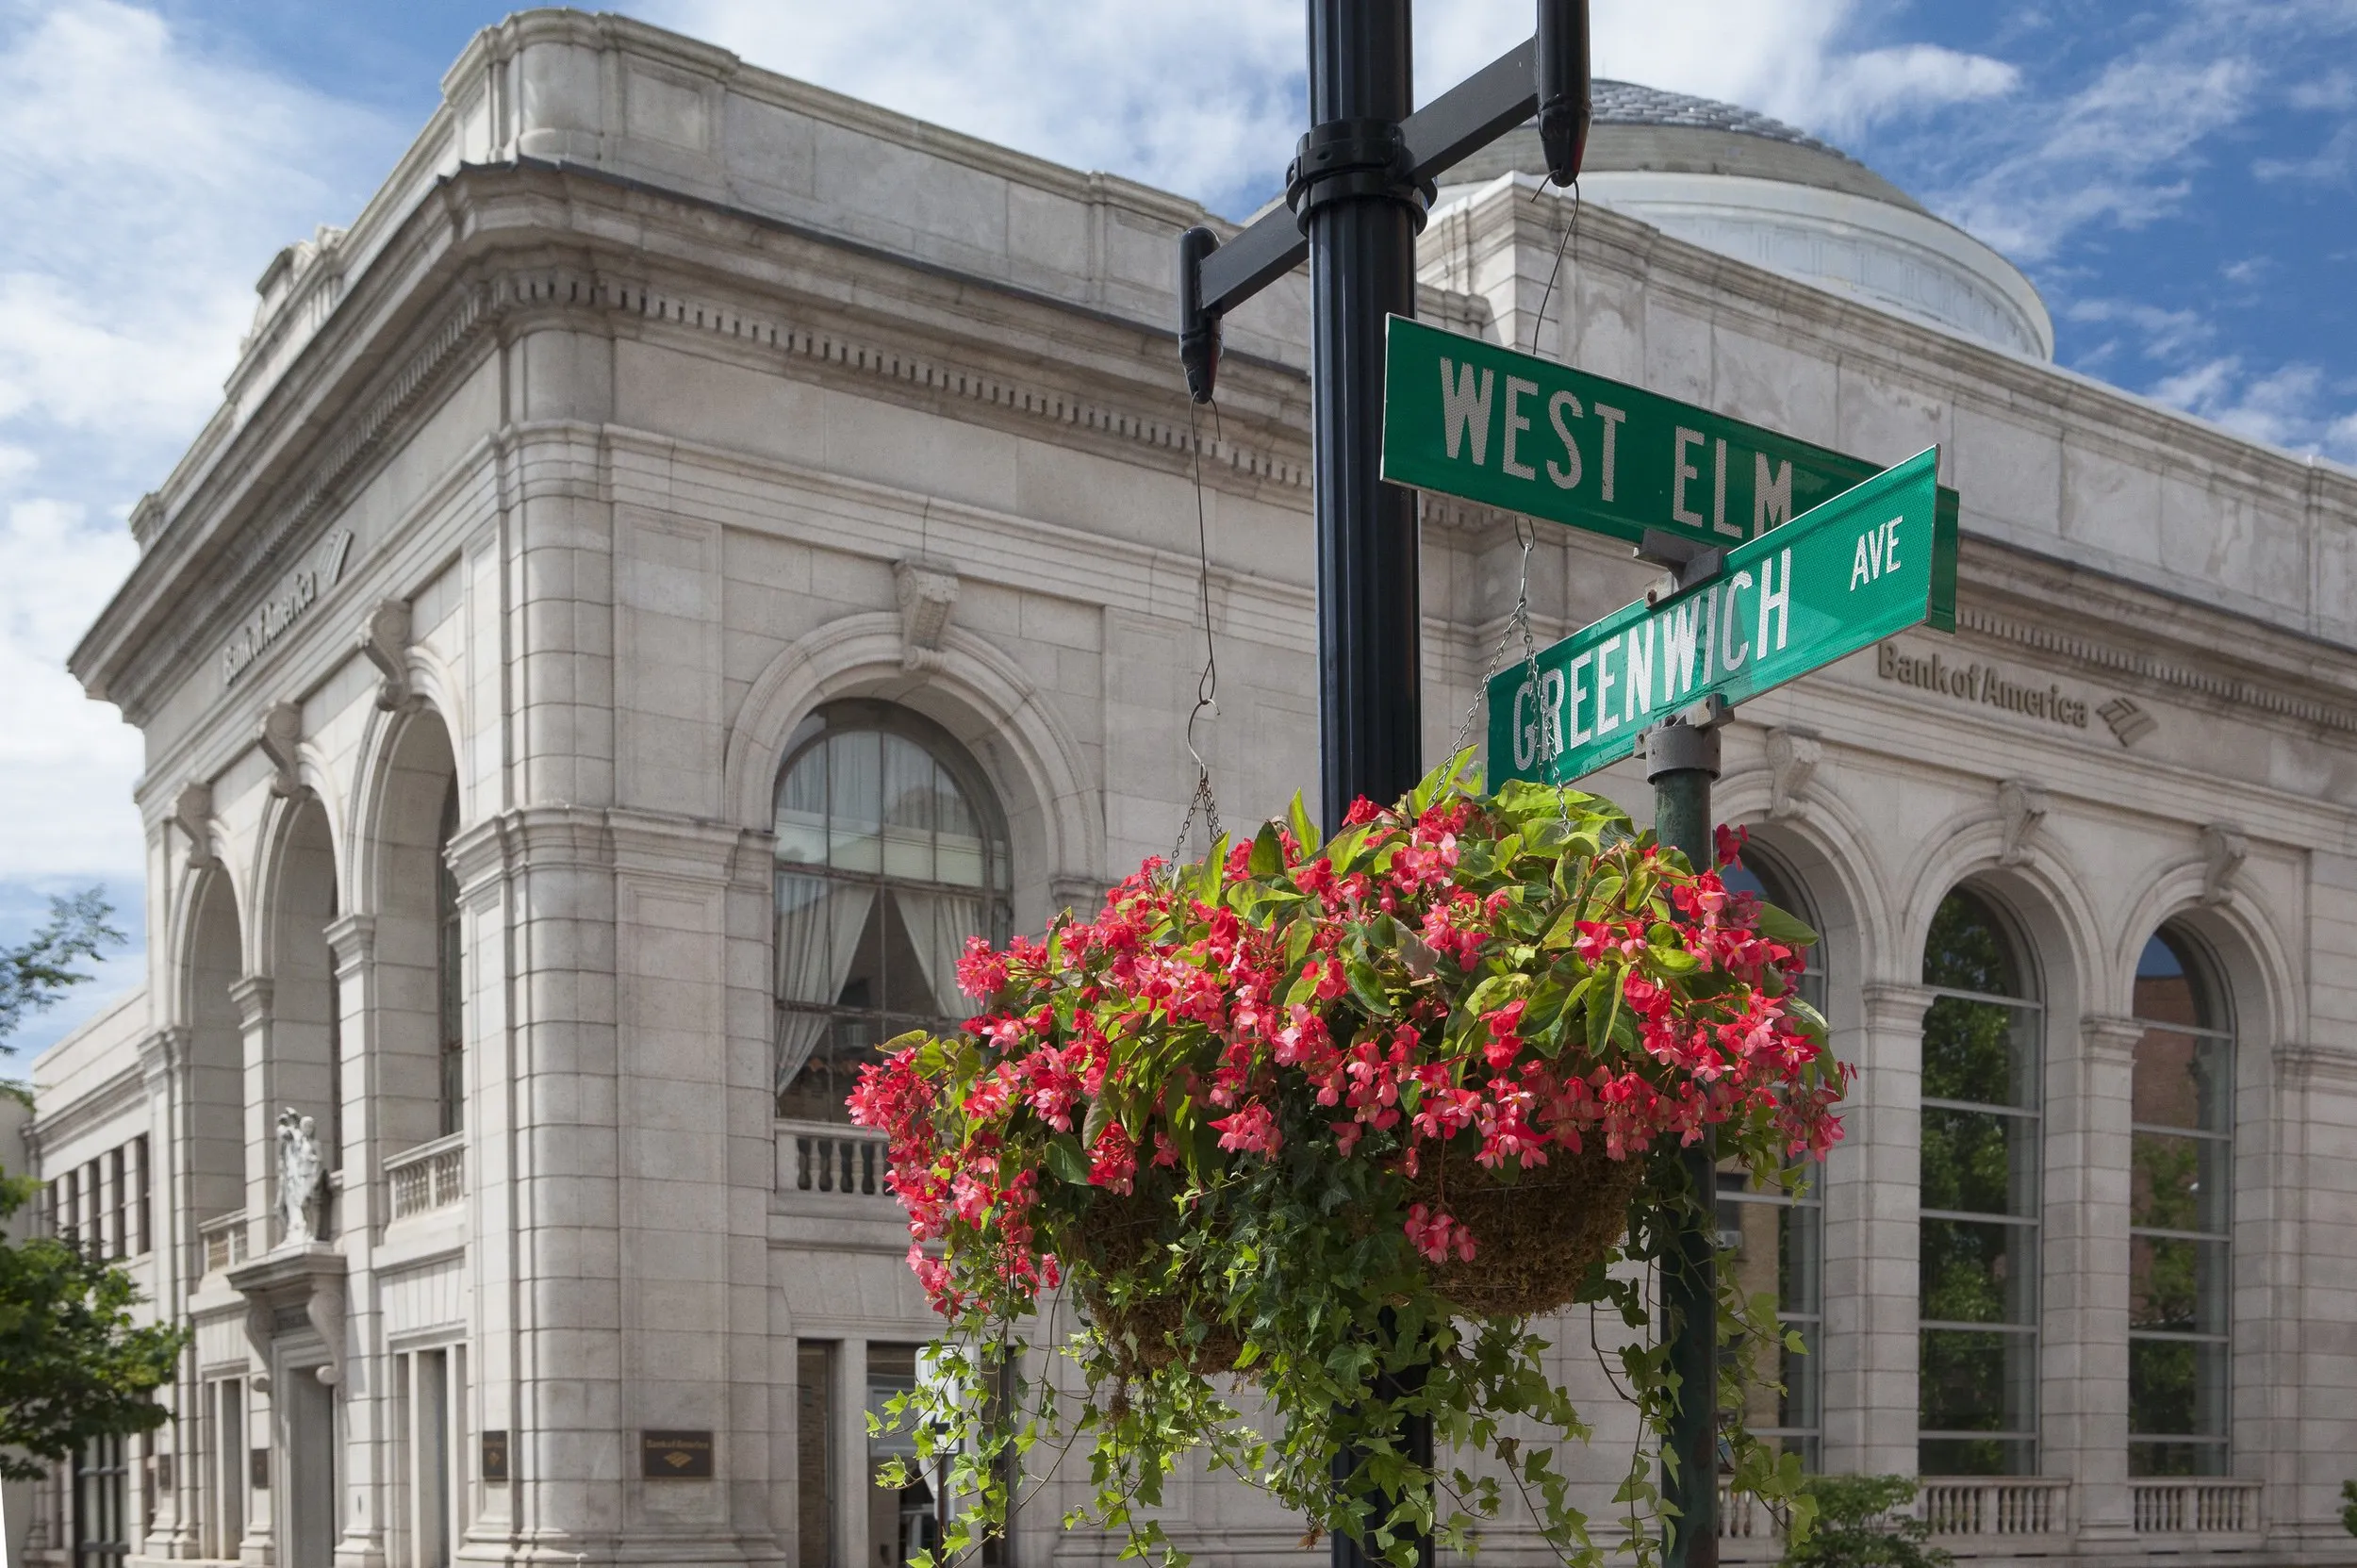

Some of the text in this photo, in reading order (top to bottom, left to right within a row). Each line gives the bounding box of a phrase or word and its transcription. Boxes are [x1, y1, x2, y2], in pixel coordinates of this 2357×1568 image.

[1439, 356, 1792, 540] WEST ELM
[1512, 515, 1904, 771] GREENWICH AVE
[1876, 639, 2090, 729] Bank of America
